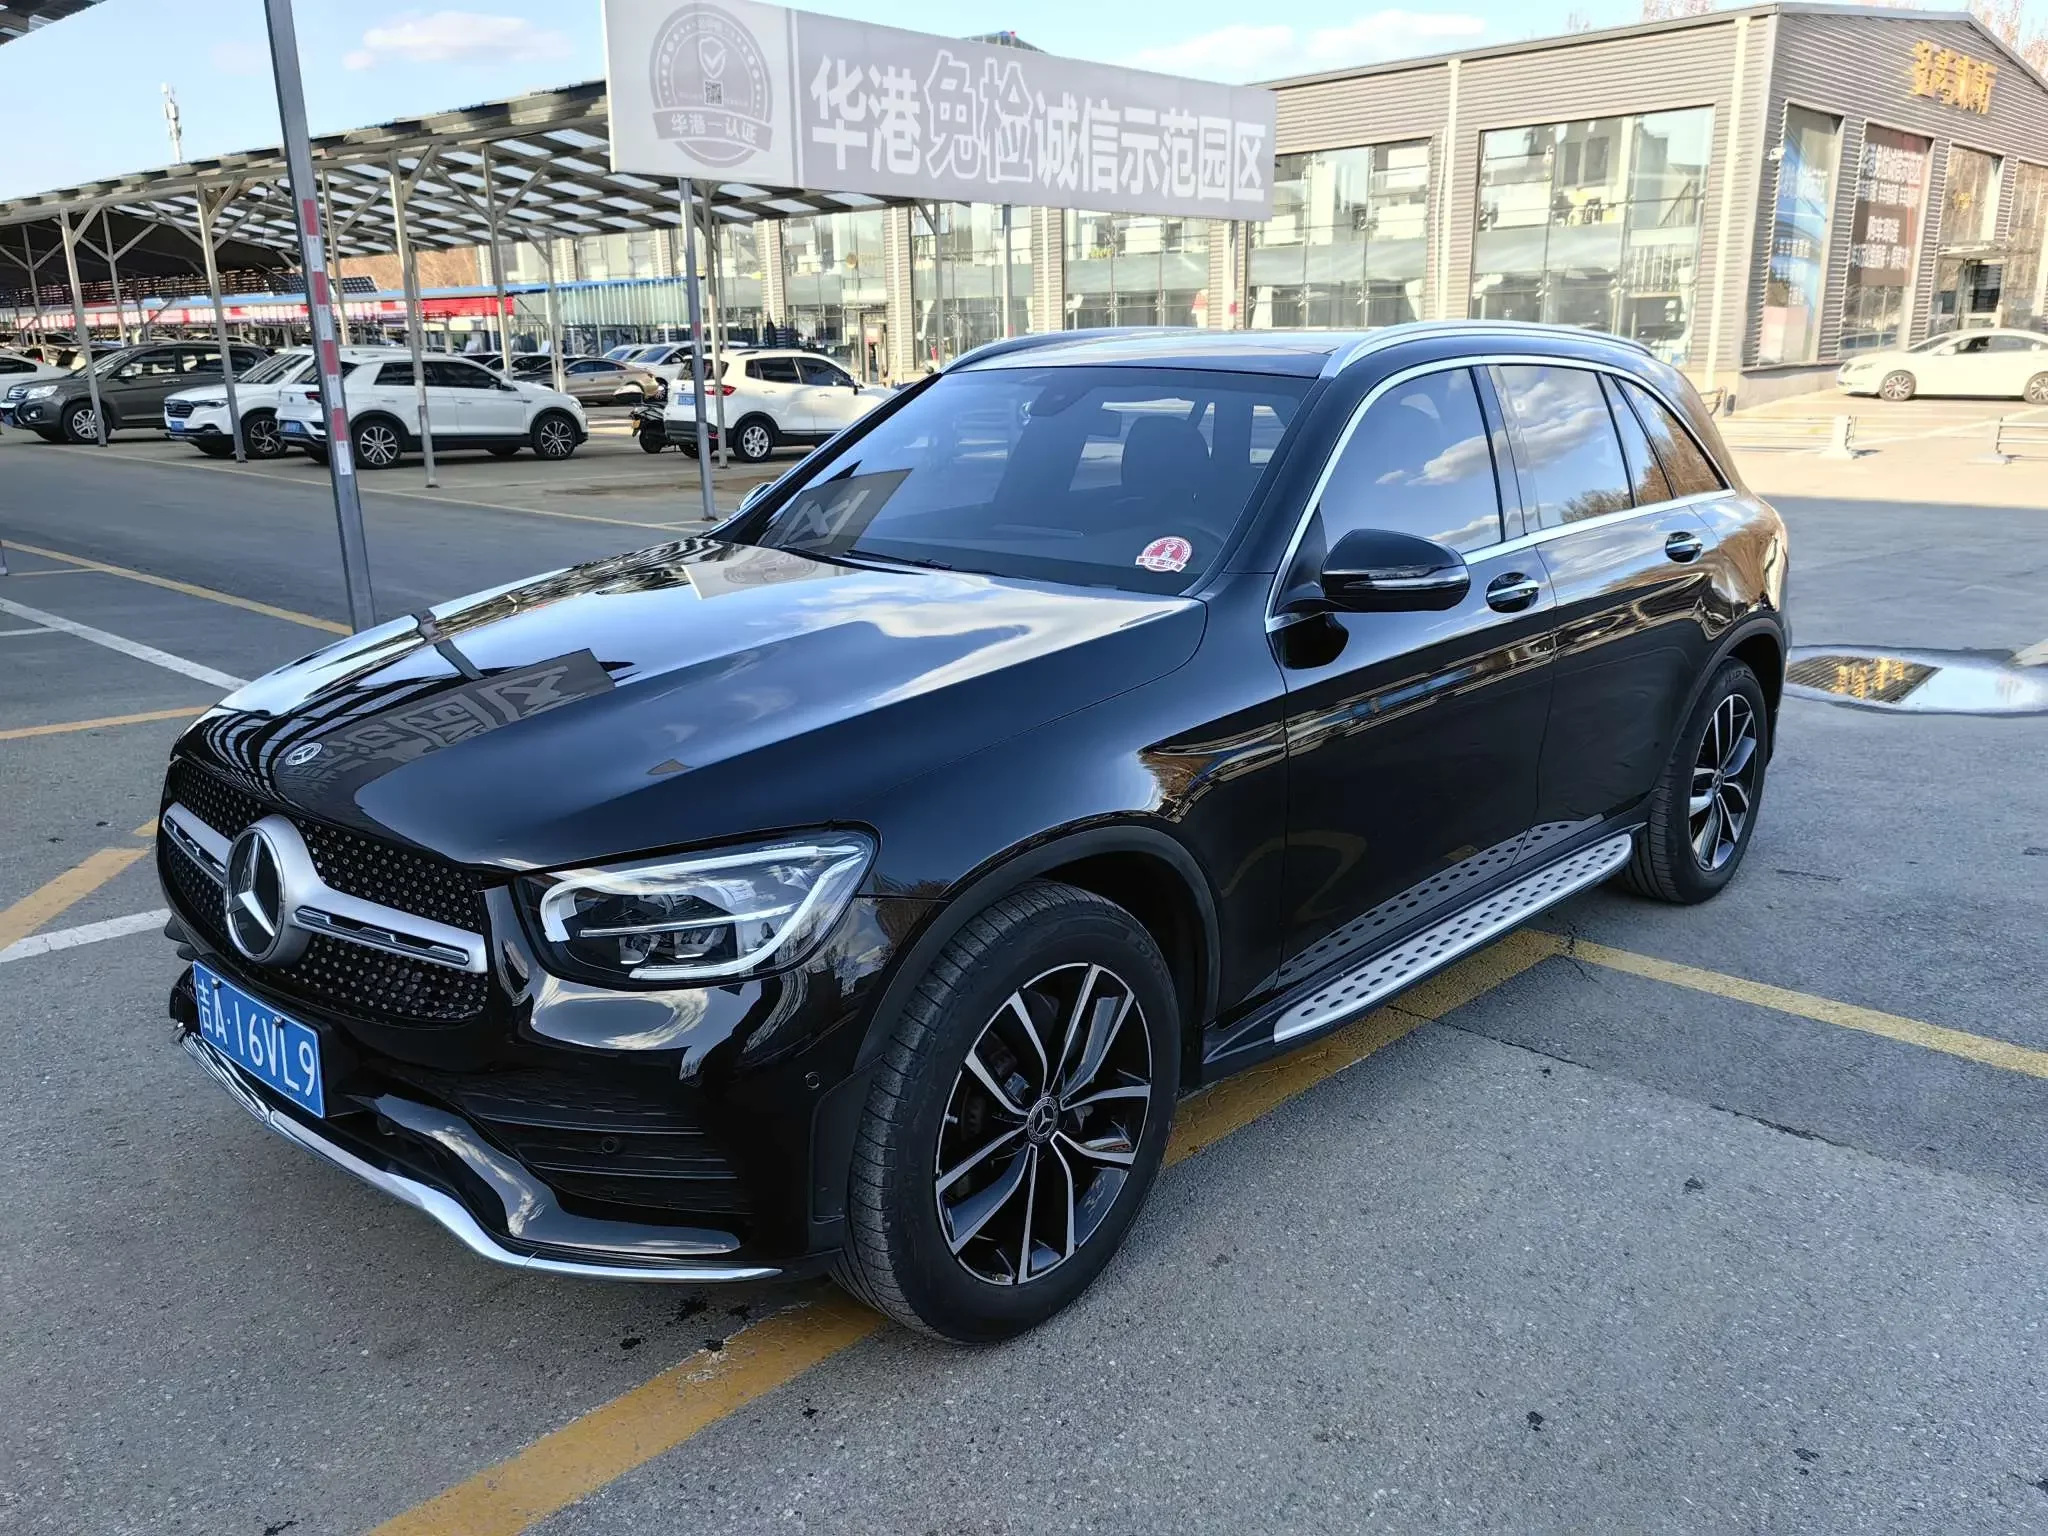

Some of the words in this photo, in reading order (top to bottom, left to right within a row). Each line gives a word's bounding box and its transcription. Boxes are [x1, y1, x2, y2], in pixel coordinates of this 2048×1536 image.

[810, 50, 1266, 202] 华港免检诚信示范园区
